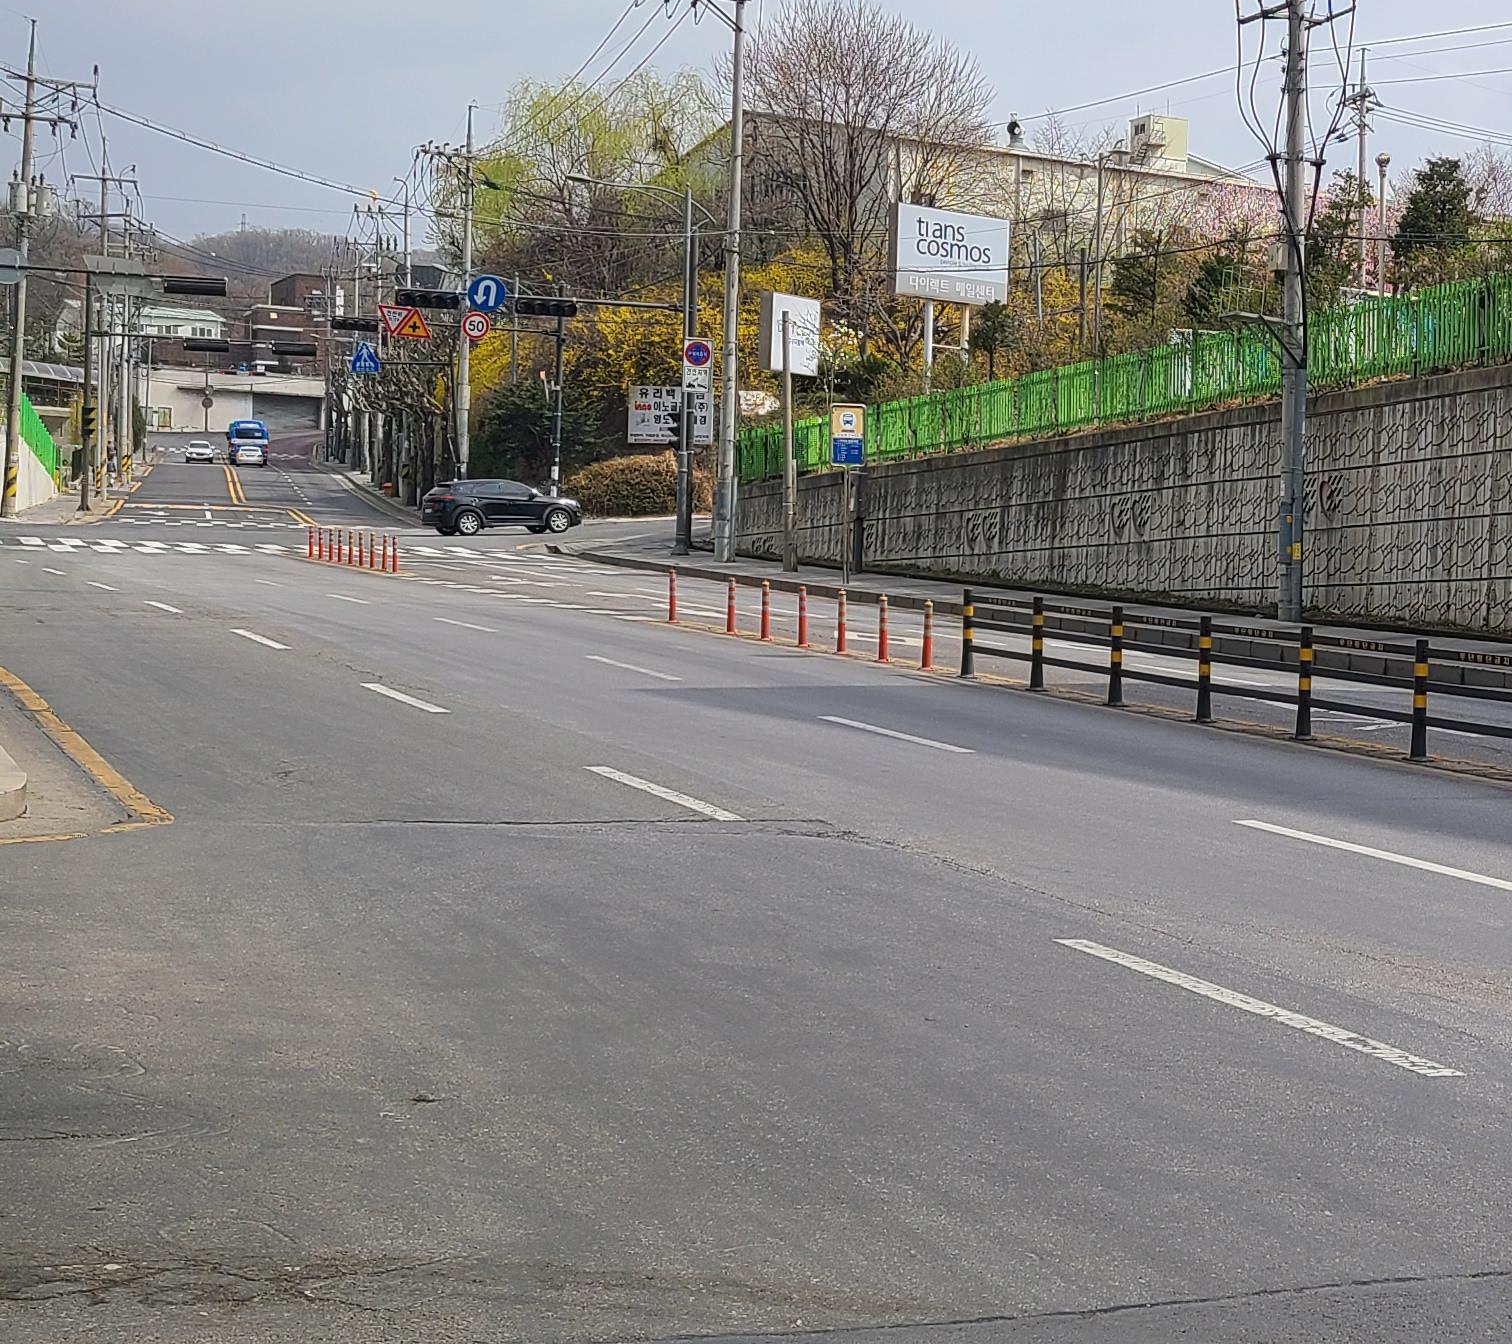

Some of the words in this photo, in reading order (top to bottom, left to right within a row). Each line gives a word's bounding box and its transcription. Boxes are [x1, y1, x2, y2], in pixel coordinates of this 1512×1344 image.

[916, 217, 965, 242] trans
[916, 239, 991, 264] cosmos
[468, 321, 485, 332] 50
